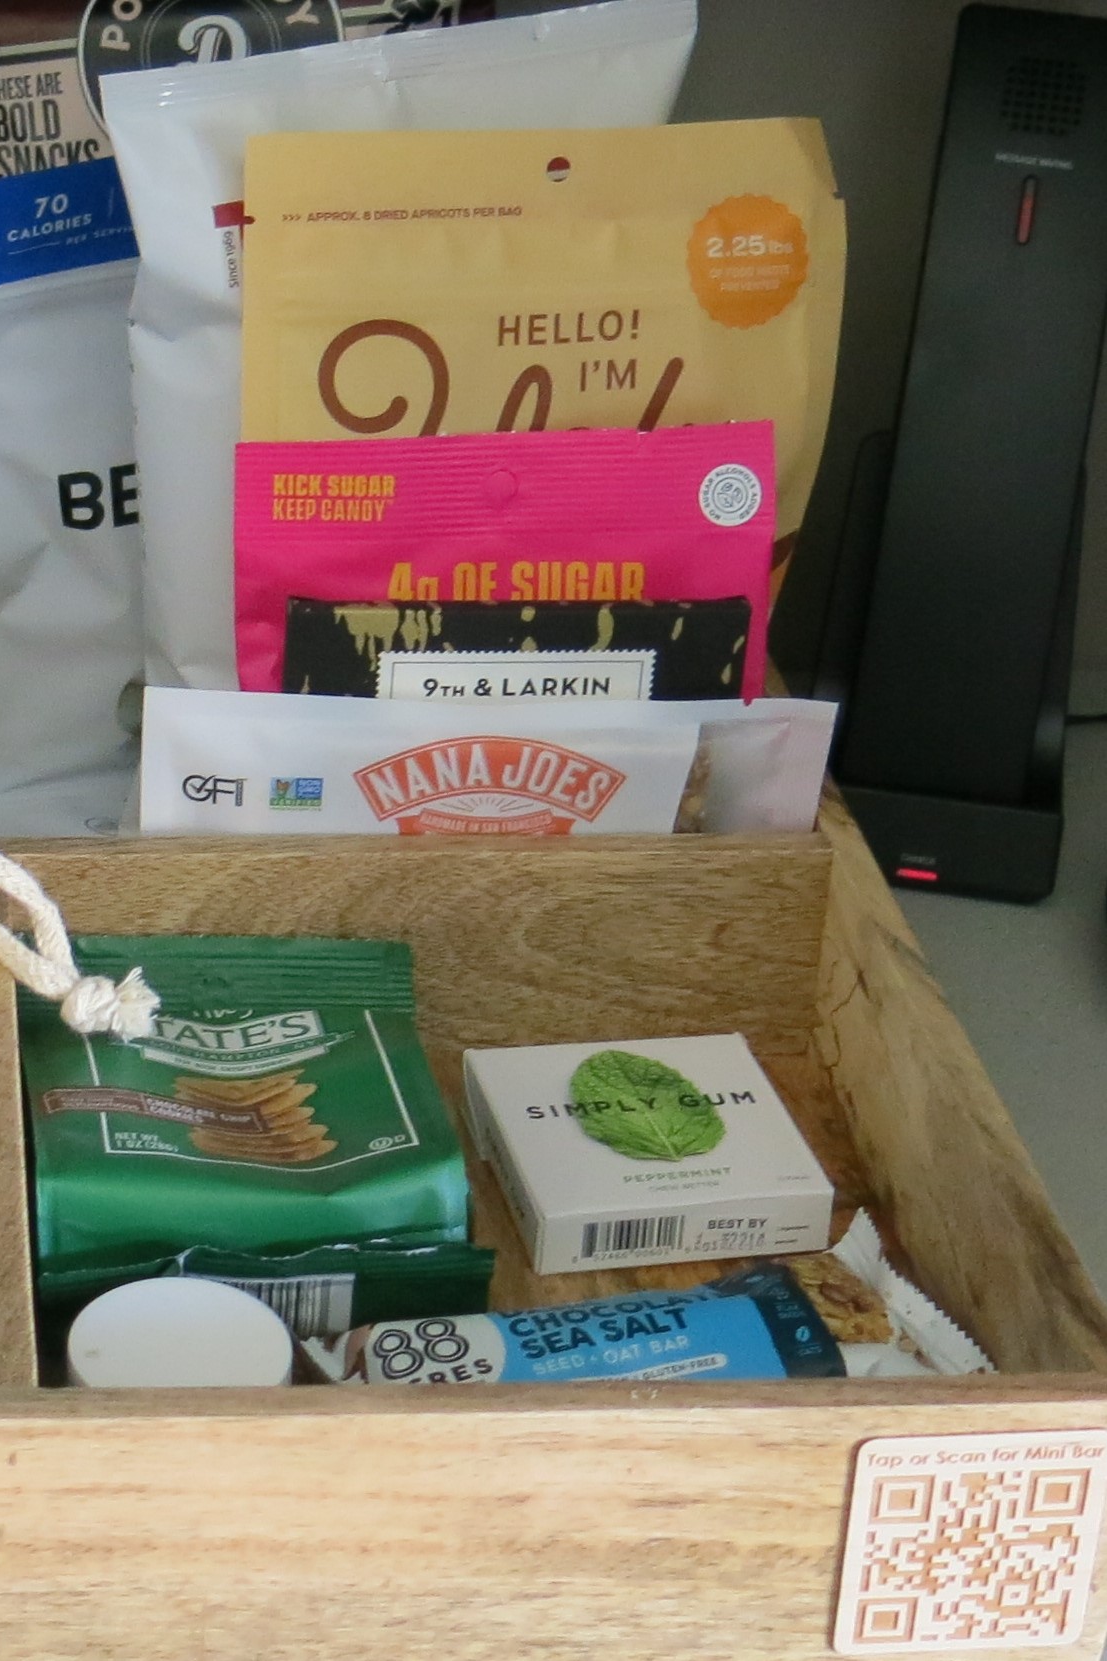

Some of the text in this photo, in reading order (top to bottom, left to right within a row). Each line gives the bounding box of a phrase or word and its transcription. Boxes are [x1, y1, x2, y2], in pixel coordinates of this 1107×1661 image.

[36, 72, 63, 96] ARE
[35, 193, 69, 219] 70
[306, 210, 360, 223] APPROX.
[374, 209, 408, 221] DRIED
[411, 207, 471, 219] APRICOTS
[472, 207, 495, 218] PER
[498, 205, 524, 217] BAG
[7, 213, 92, 242] CALORIES
[66, 234, 87, 245] PER
[223, 230, 240, 289] Since 1969
[707, 235, 766, 258] 2.25
[496, 309, 641, 347] HELLO!
[579, 359, 638, 393] I'M
[273, 474, 395, 497] KICK SUGAR
[273, 498, 385, 522] KEEP CANDY
[453, 561, 498, 601] OF
[510, 561, 646, 601] SUGAR
[423, 677, 611, 697] 9TH & LARKIN
[366, 743, 611, 812] NANA JOES
[154, 1013, 313, 1049] TATE'S
[525, 1090, 758, 1120] SIMPLY GUM
[622, 1167, 733, 1184] PEPPERMINT
[707, 1218, 768, 1230] BEST BY
[519, 1308, 690, 1360] SEA SALT
[372, 1318, 471, 1381] 88
[533, 1353, 585, 1375] SEED
[603, 1344, 641, 1364] OAT
[650, 1335, 689, 1353] BAR
[642, 1356, 719, 1381] GLUTEN-FREE
[867, 1443, 1106, 1469] Tap or Scan for Mini Bar
